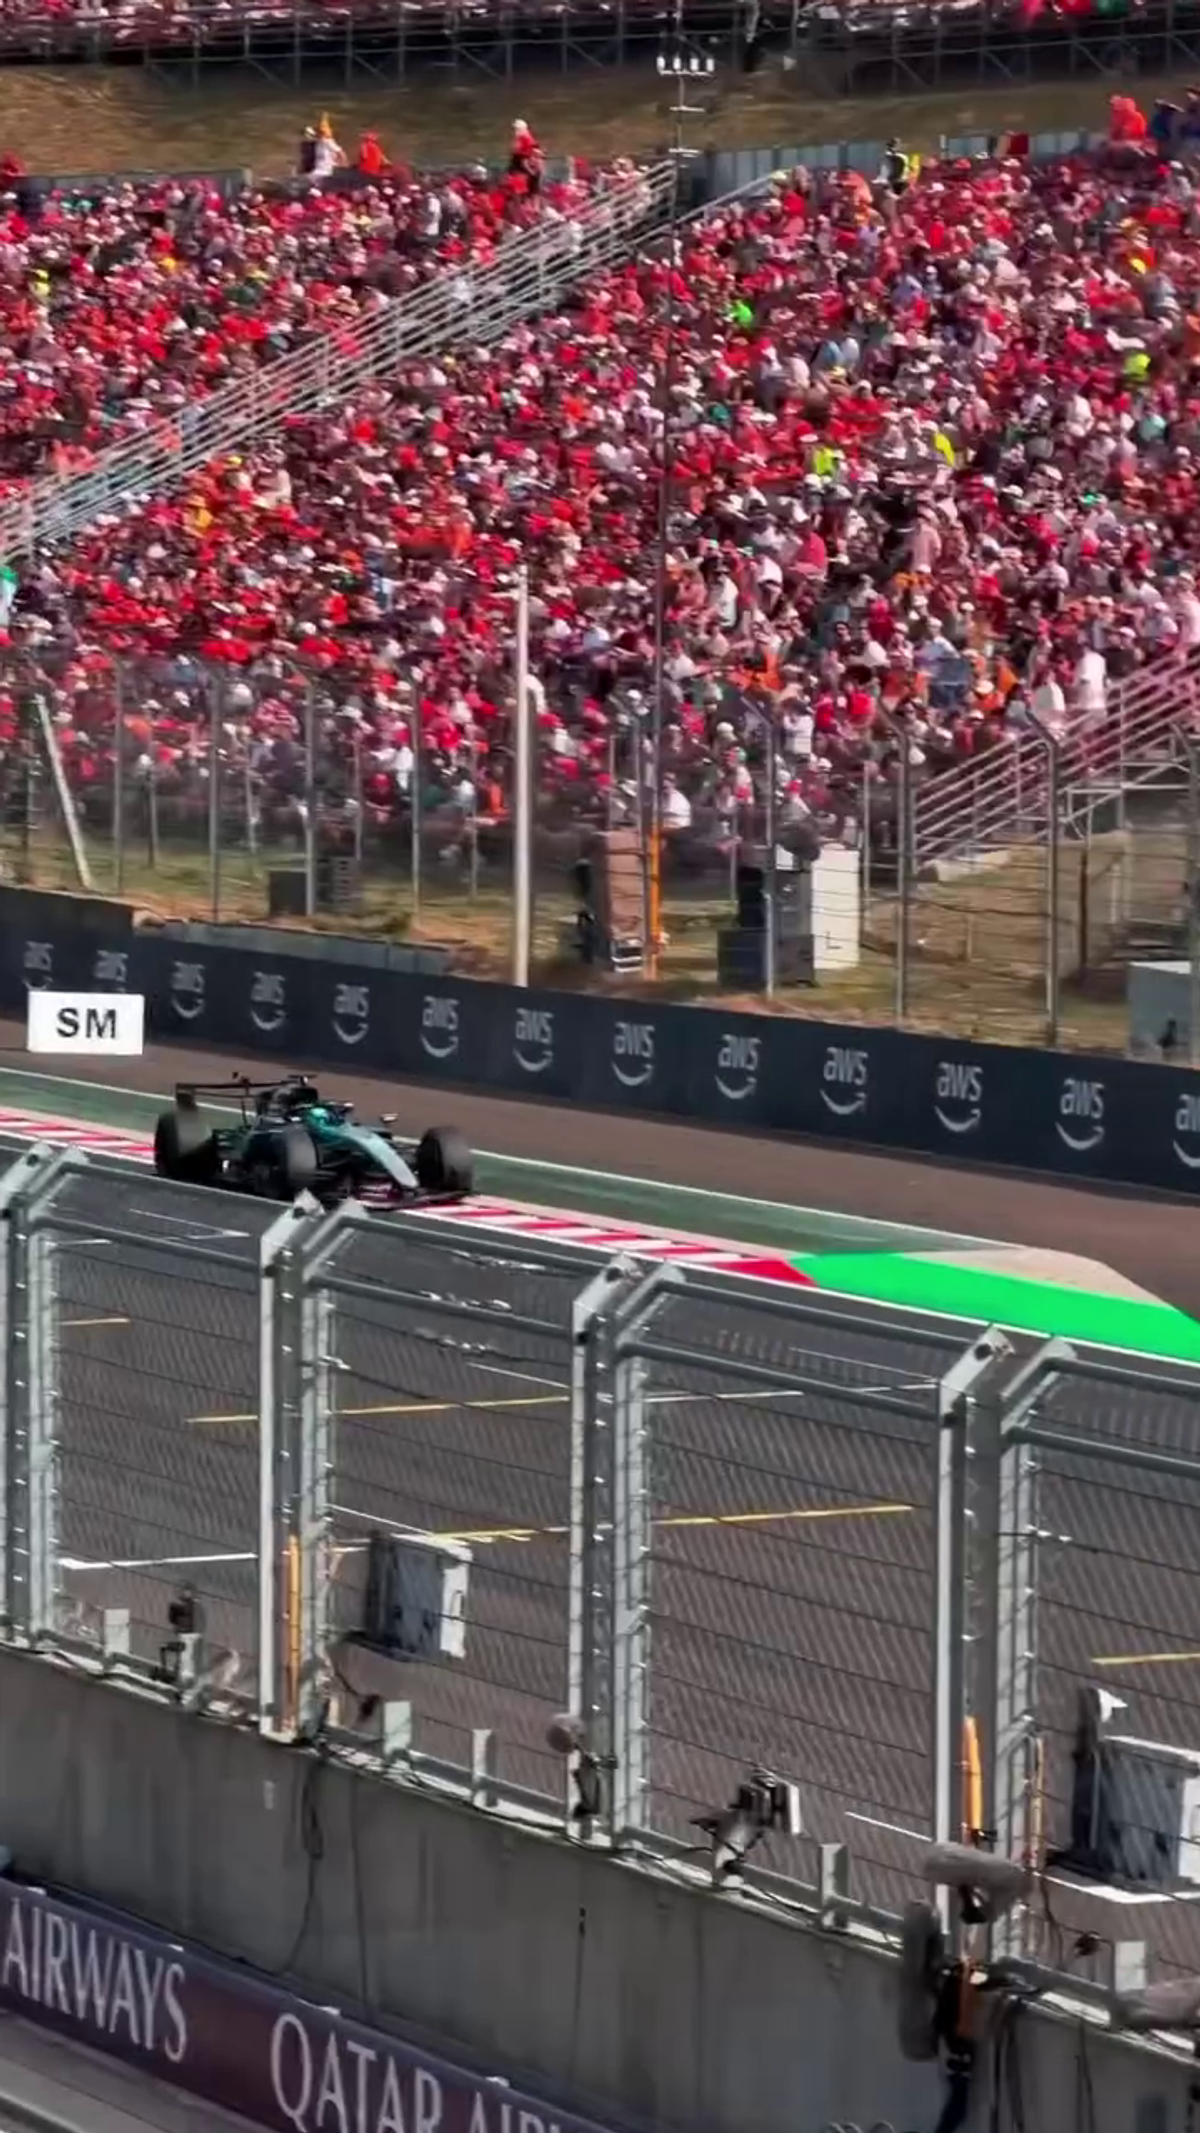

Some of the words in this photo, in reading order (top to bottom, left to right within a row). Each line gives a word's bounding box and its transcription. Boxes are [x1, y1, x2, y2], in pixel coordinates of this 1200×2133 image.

[56, 1007, 117, 1039] SM
[422, 996, 459, 1030] aws
[515, 1008, 554, 1044] aws
[614, 1022, 655, 1057] aws
[718, 1034, 761, 1071] aws
[823, 1047, 868, 1085] aws
[936, 1062, 983, 1101] aws
[1060, 1078, 1104, 1119] aws
[2, 1897, 187, 2063] AIRWAYS
[271, 2013, 442, 2133] QATAR
